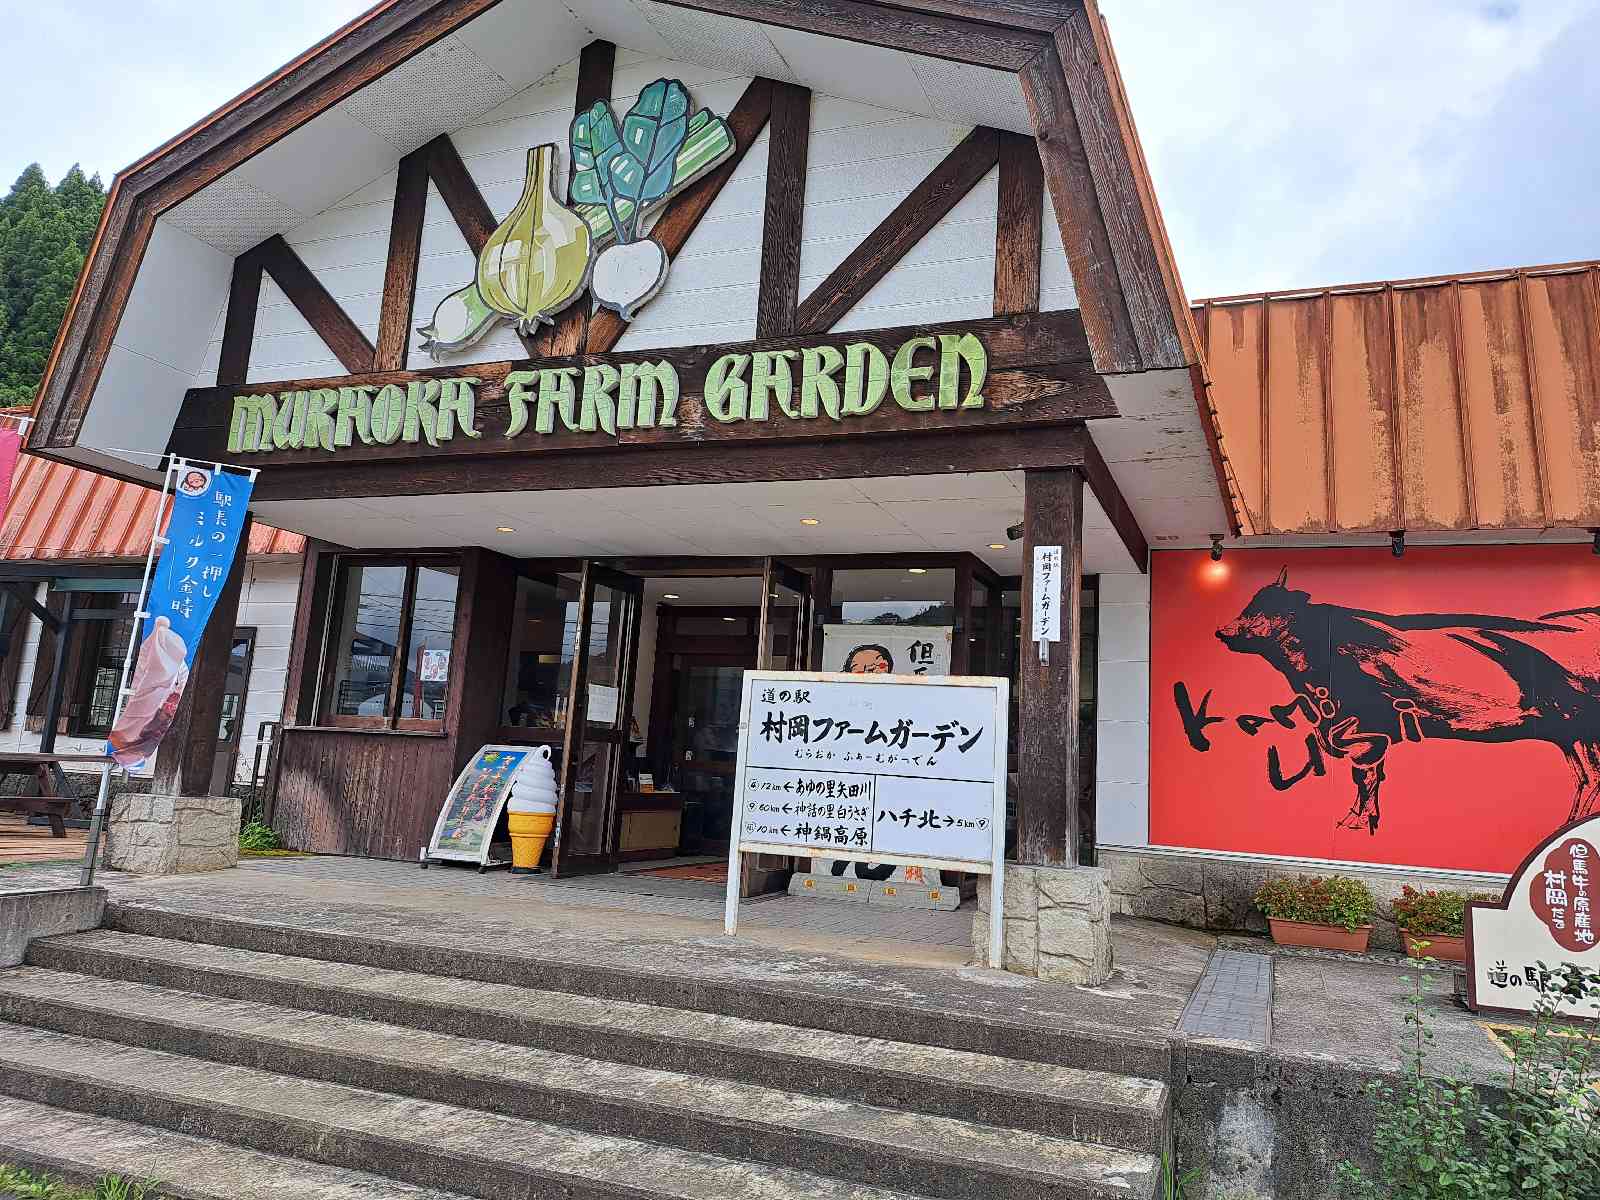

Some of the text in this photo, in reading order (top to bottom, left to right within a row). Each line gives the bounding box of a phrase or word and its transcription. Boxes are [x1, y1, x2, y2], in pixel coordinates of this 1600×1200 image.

[227, 332, 988, 454] MURAOKA FARM GARDEN
[201, 490, 232, 598] 駅長の一押し
[171, 510, 204, 618] ミルク金時
[1039, 551, 1052, 636] 村岡ファームガーデン
[761, 688, 811, 705] 道の駅
[760, 711, 984, 754] 村岡ファームガーデン
[794, 748, 836, 760] むらおか
[795, 777, 872, 801] あゆの里矢田川
[794, 801, 870, 821] 神話の里白うさぎ
[877, 808, 942, 828] ハチ北
[793, 821, 869, 846] 神鍋高原
